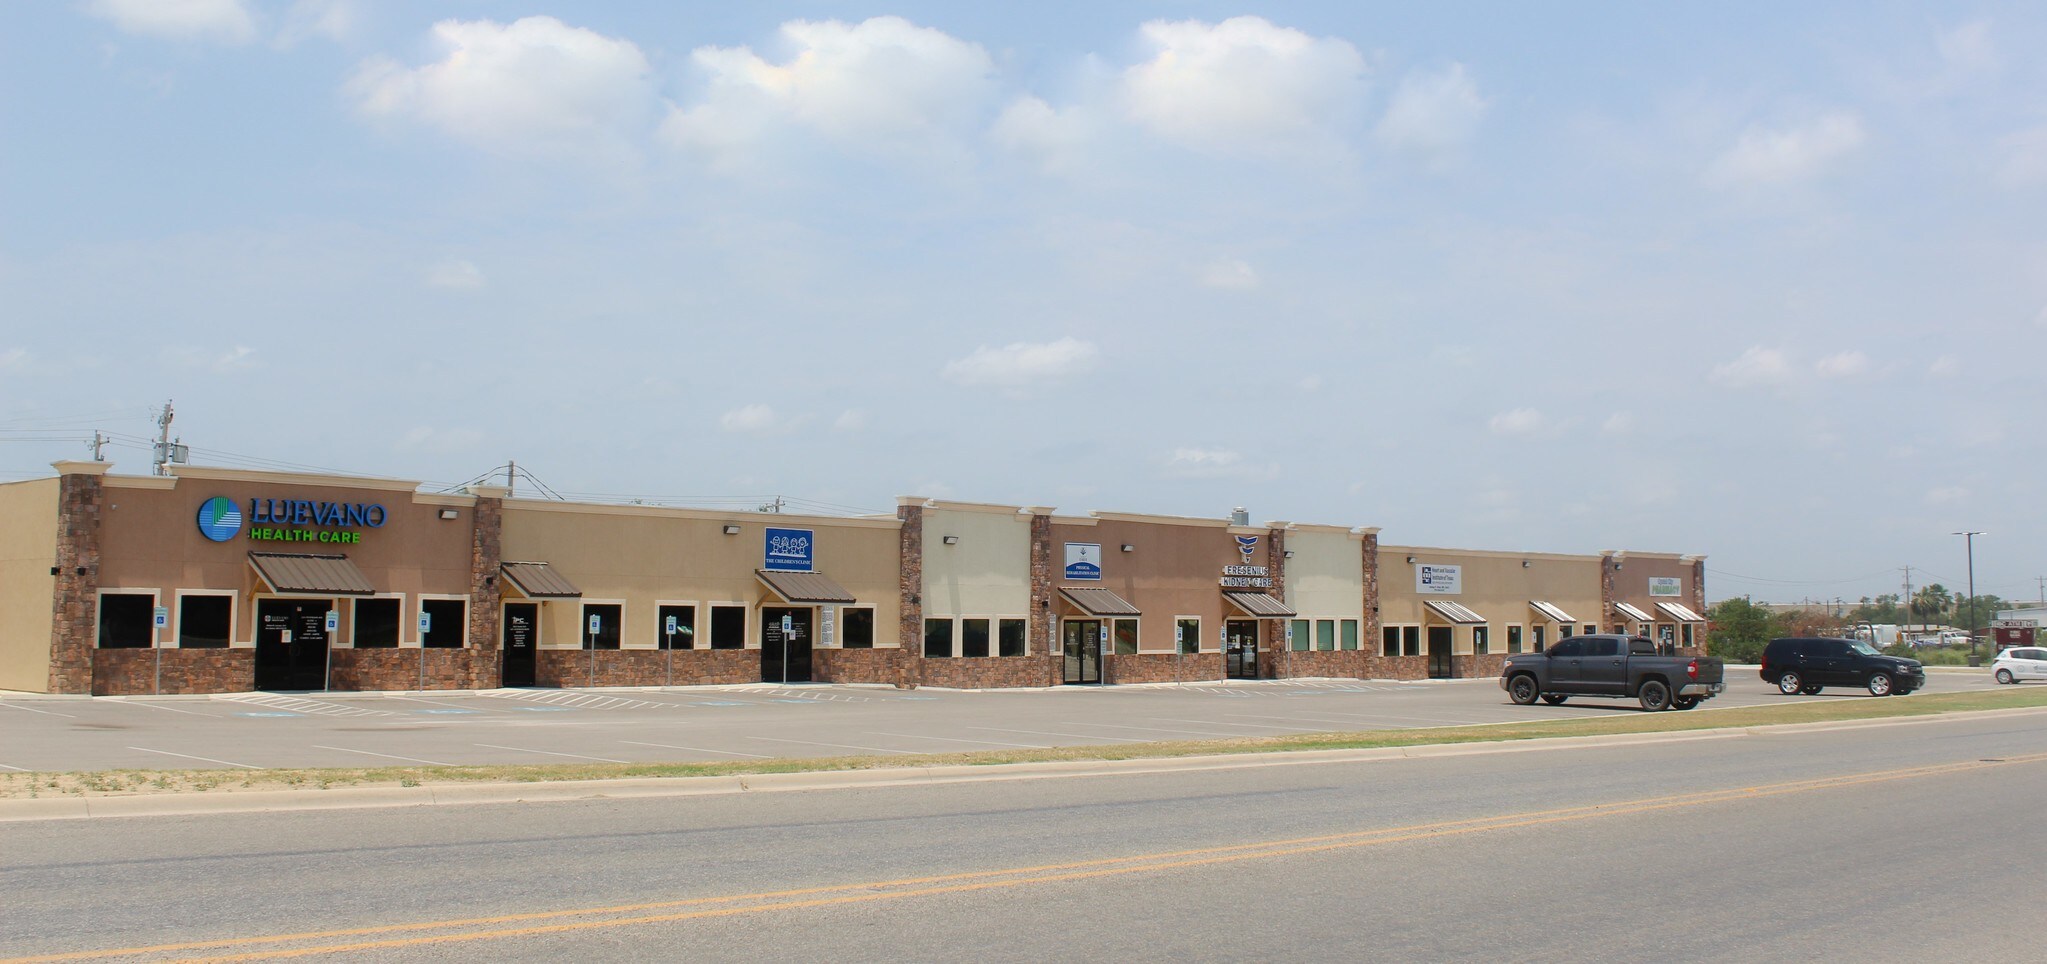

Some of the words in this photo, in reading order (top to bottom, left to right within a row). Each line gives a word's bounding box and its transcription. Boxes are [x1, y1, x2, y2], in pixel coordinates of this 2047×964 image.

[251, 498, 387, 528] LUEVANO
[251, 528, 313, 541] HEALTH
[319, 531, 361, 544] CARE
[1226, 566, 1269, 576] FRESENIUS
[1223, 577, 1250, 587] KIDNEY
[1253, 578, 1272, 587] CARE
